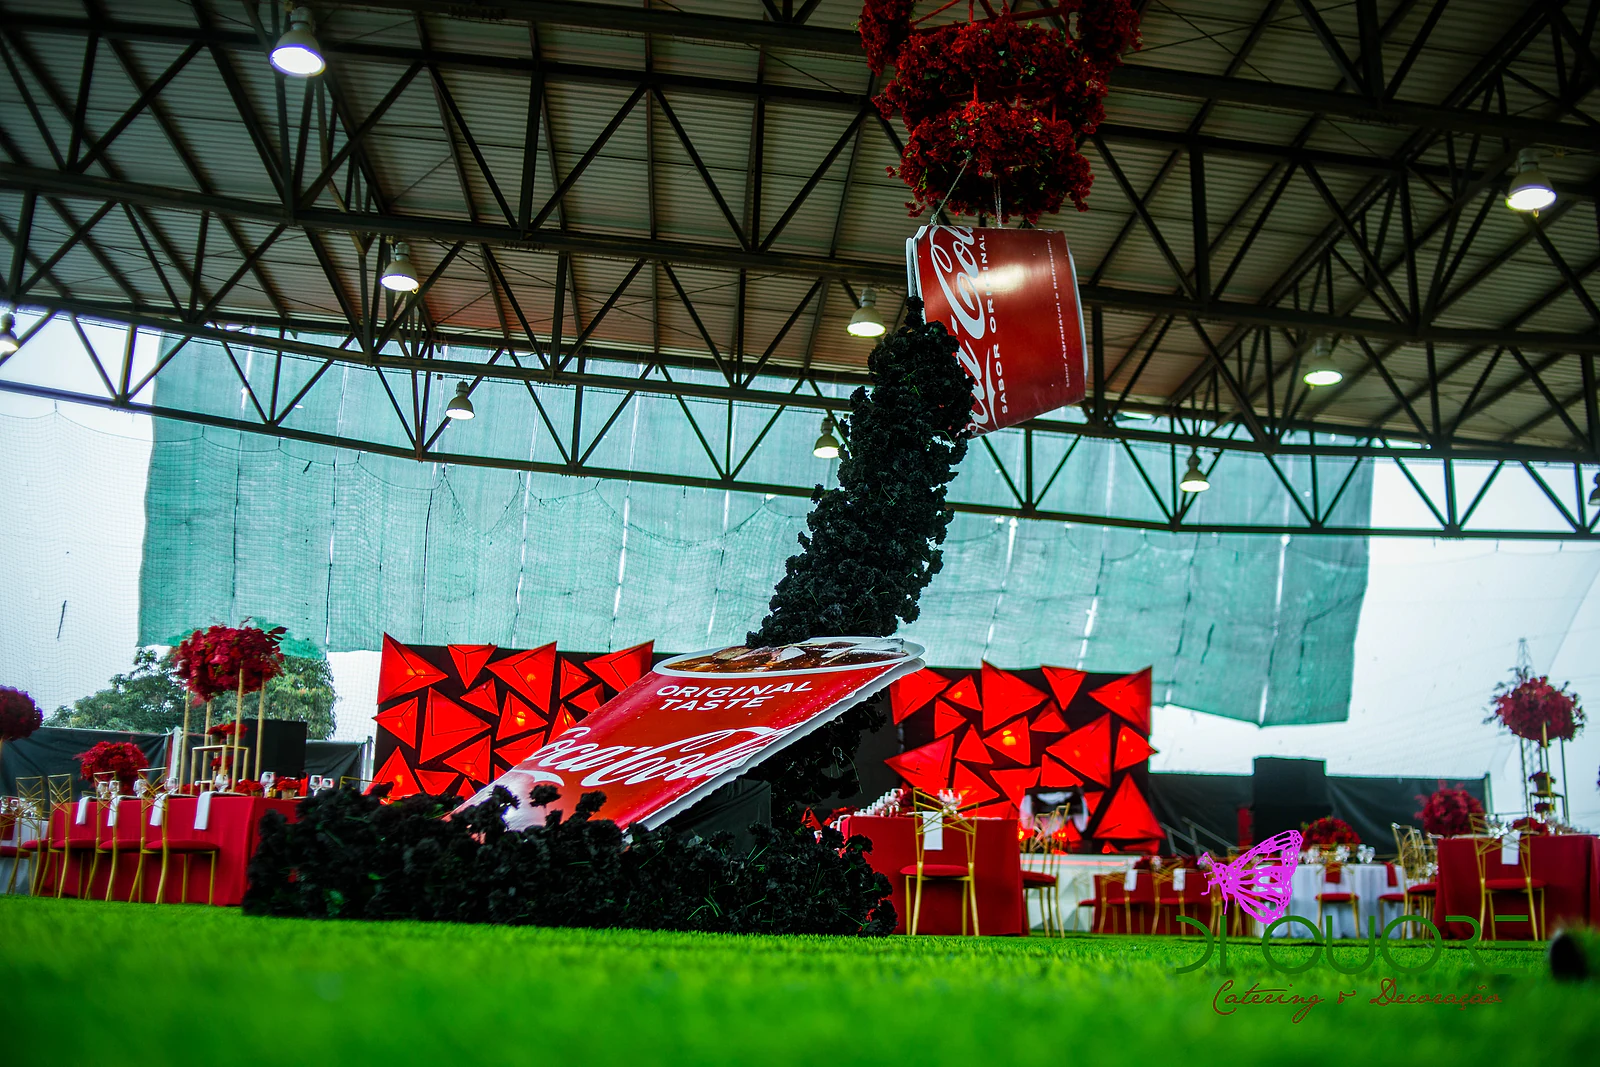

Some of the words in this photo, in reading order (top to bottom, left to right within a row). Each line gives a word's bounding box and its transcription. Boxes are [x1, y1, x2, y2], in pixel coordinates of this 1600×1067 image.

[992, 343, 1009, 414] SABOR
[655, 680, 814, 699] ORIGINAL
[658, 695, 775, 711] TASTE
